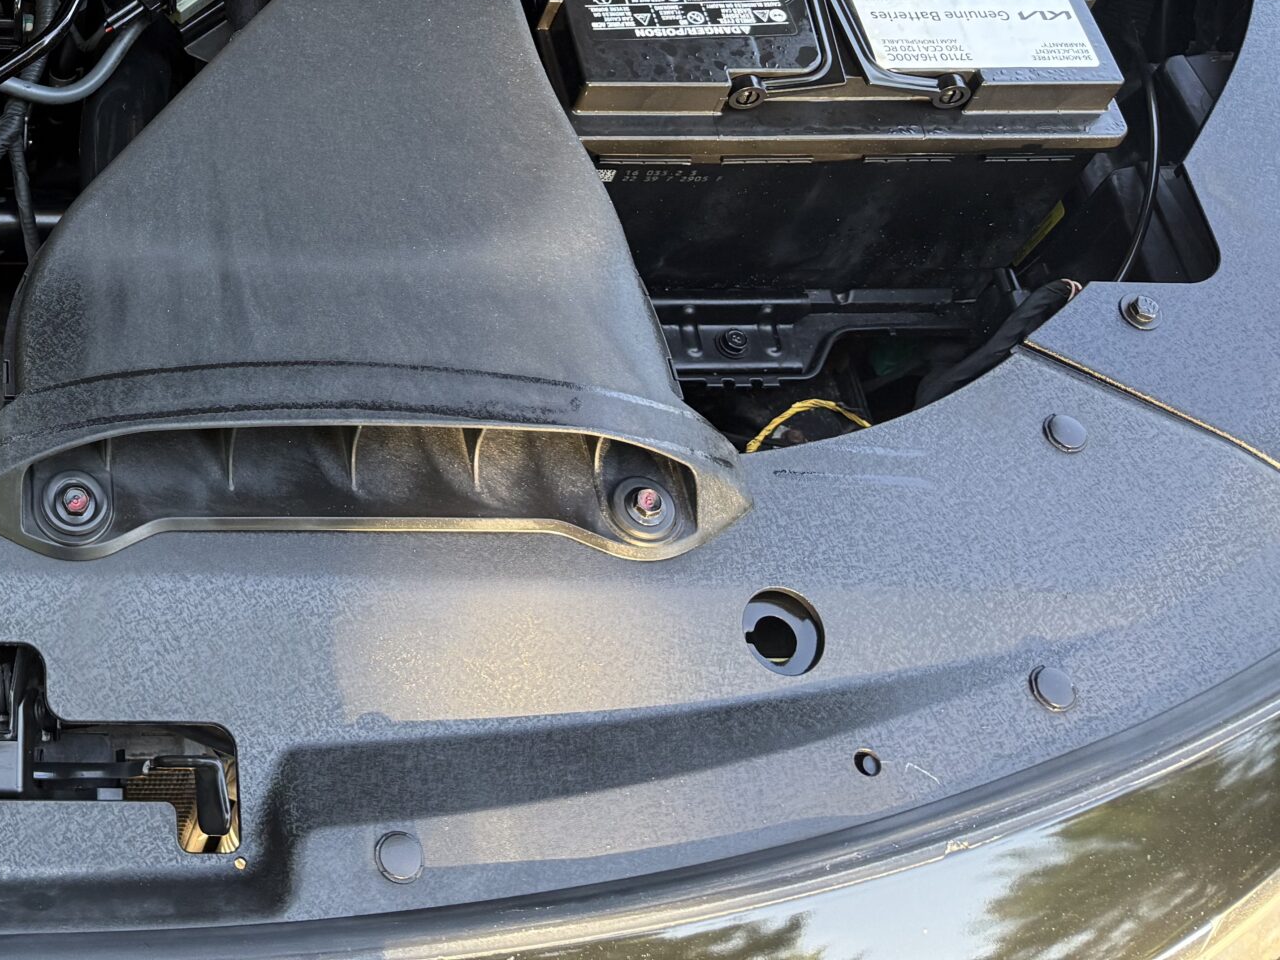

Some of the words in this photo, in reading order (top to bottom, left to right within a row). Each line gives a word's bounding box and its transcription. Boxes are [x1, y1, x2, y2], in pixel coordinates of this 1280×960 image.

[870, 10, 941, 22] Batteries
[944, 10, 1010, 22] Genuine
[1018, 10, 1072, 21] KIA
[635, 26, 742, 37] DANGER/POISON
[887, 53, 938, 62] H6A00C
[941, 53, 973, 61] 37110
